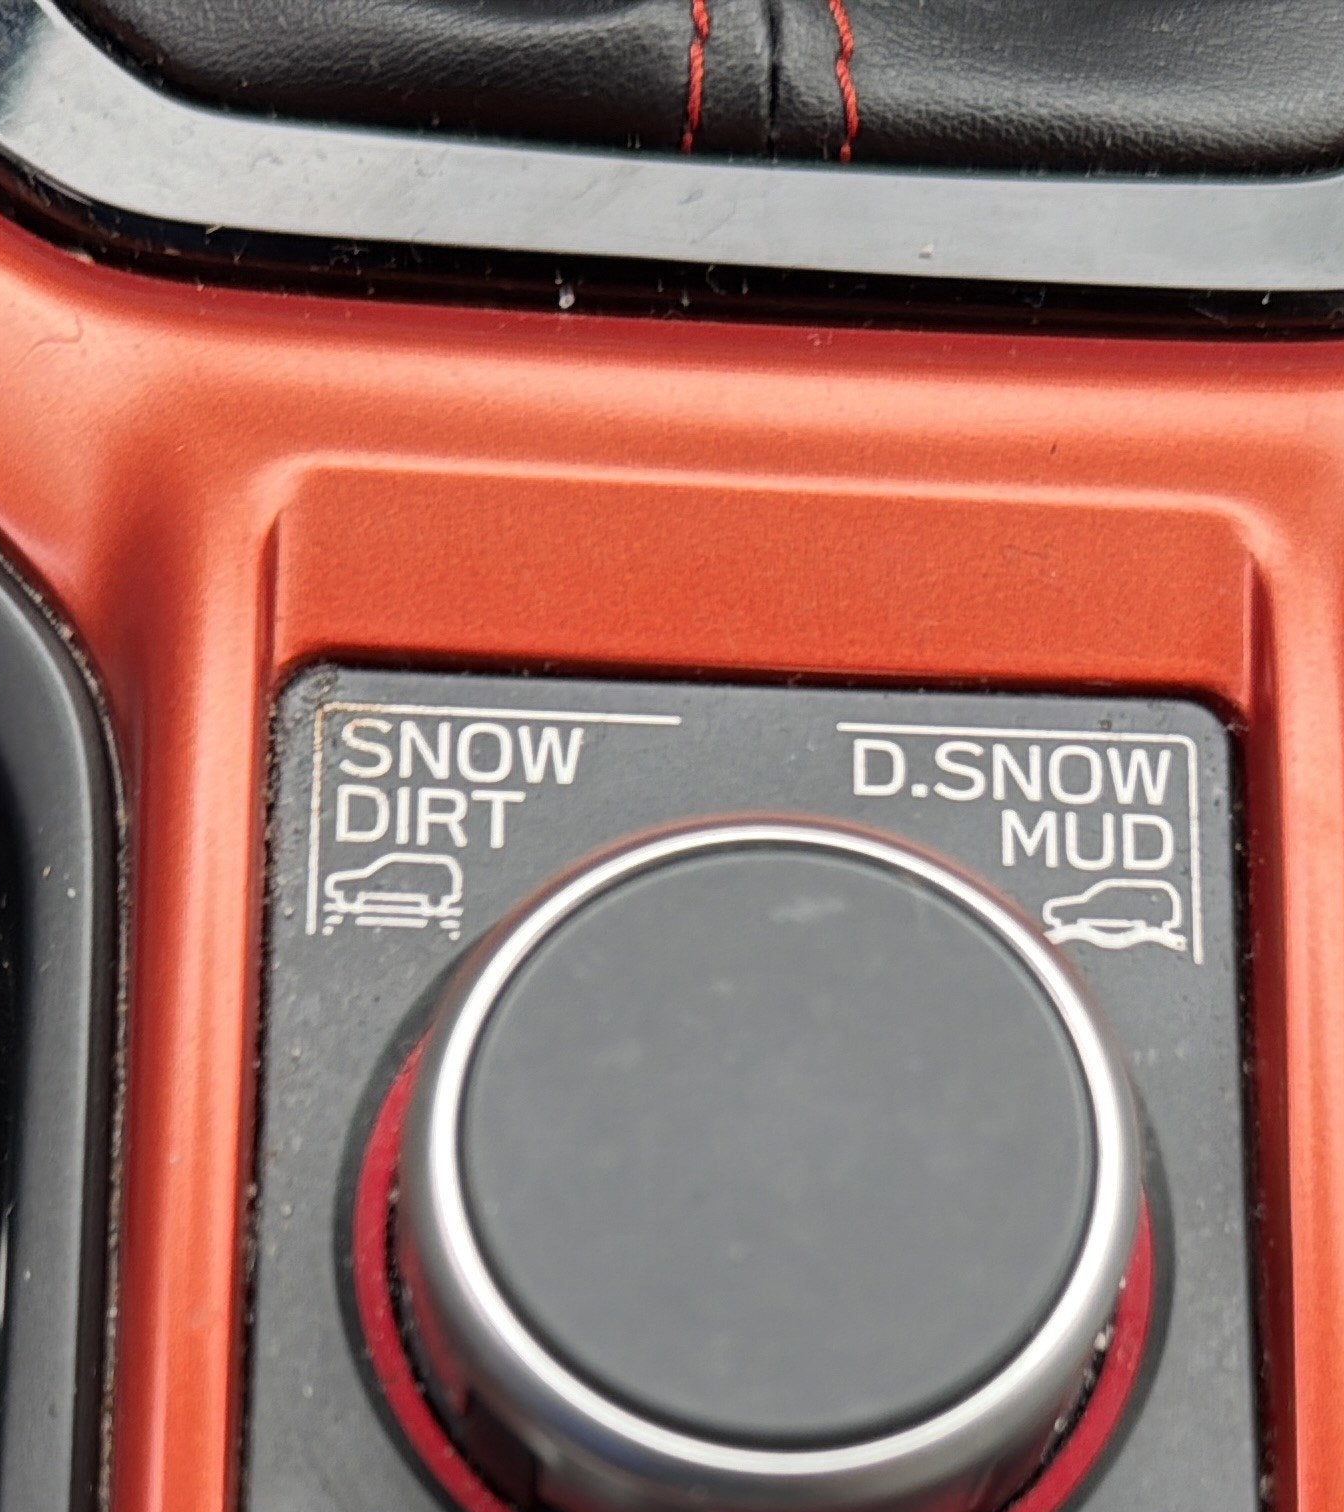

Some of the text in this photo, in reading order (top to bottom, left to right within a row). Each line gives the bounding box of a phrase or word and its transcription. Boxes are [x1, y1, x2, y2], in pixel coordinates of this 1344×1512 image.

[339, 718, 584, 785] SNOW
[853, 738, 1173, 806] D.SNOW
[335, 785, 526, 848] DIRT
[1001, 809, 1174, 871] MUD
